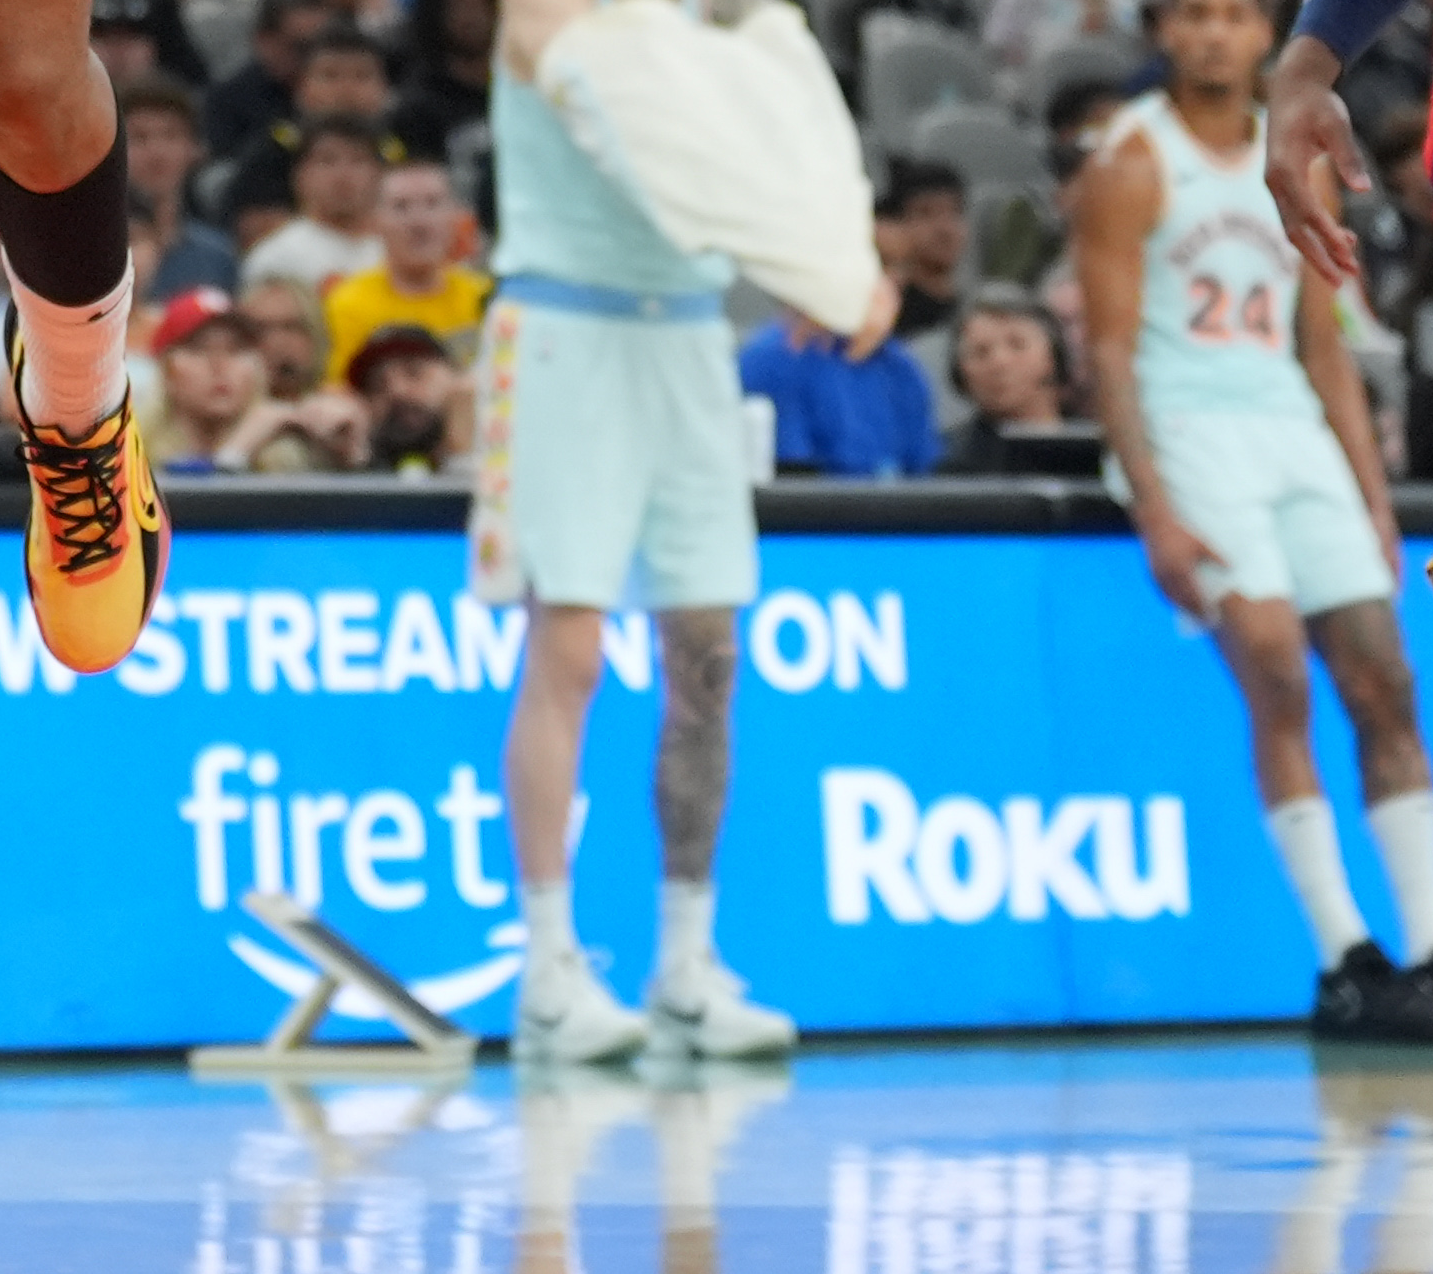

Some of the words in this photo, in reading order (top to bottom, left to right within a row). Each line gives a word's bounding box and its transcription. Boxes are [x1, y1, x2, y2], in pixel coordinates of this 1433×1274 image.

[1188, 271, 1280, 347] 24
[116, 589, 665, 695] STREAMN
[749, 589, 908, 693] ON
[178, 743, 428, 912] fire
[435, 762, 590, 909] t
[820, 765, 1191, 925] Roku
